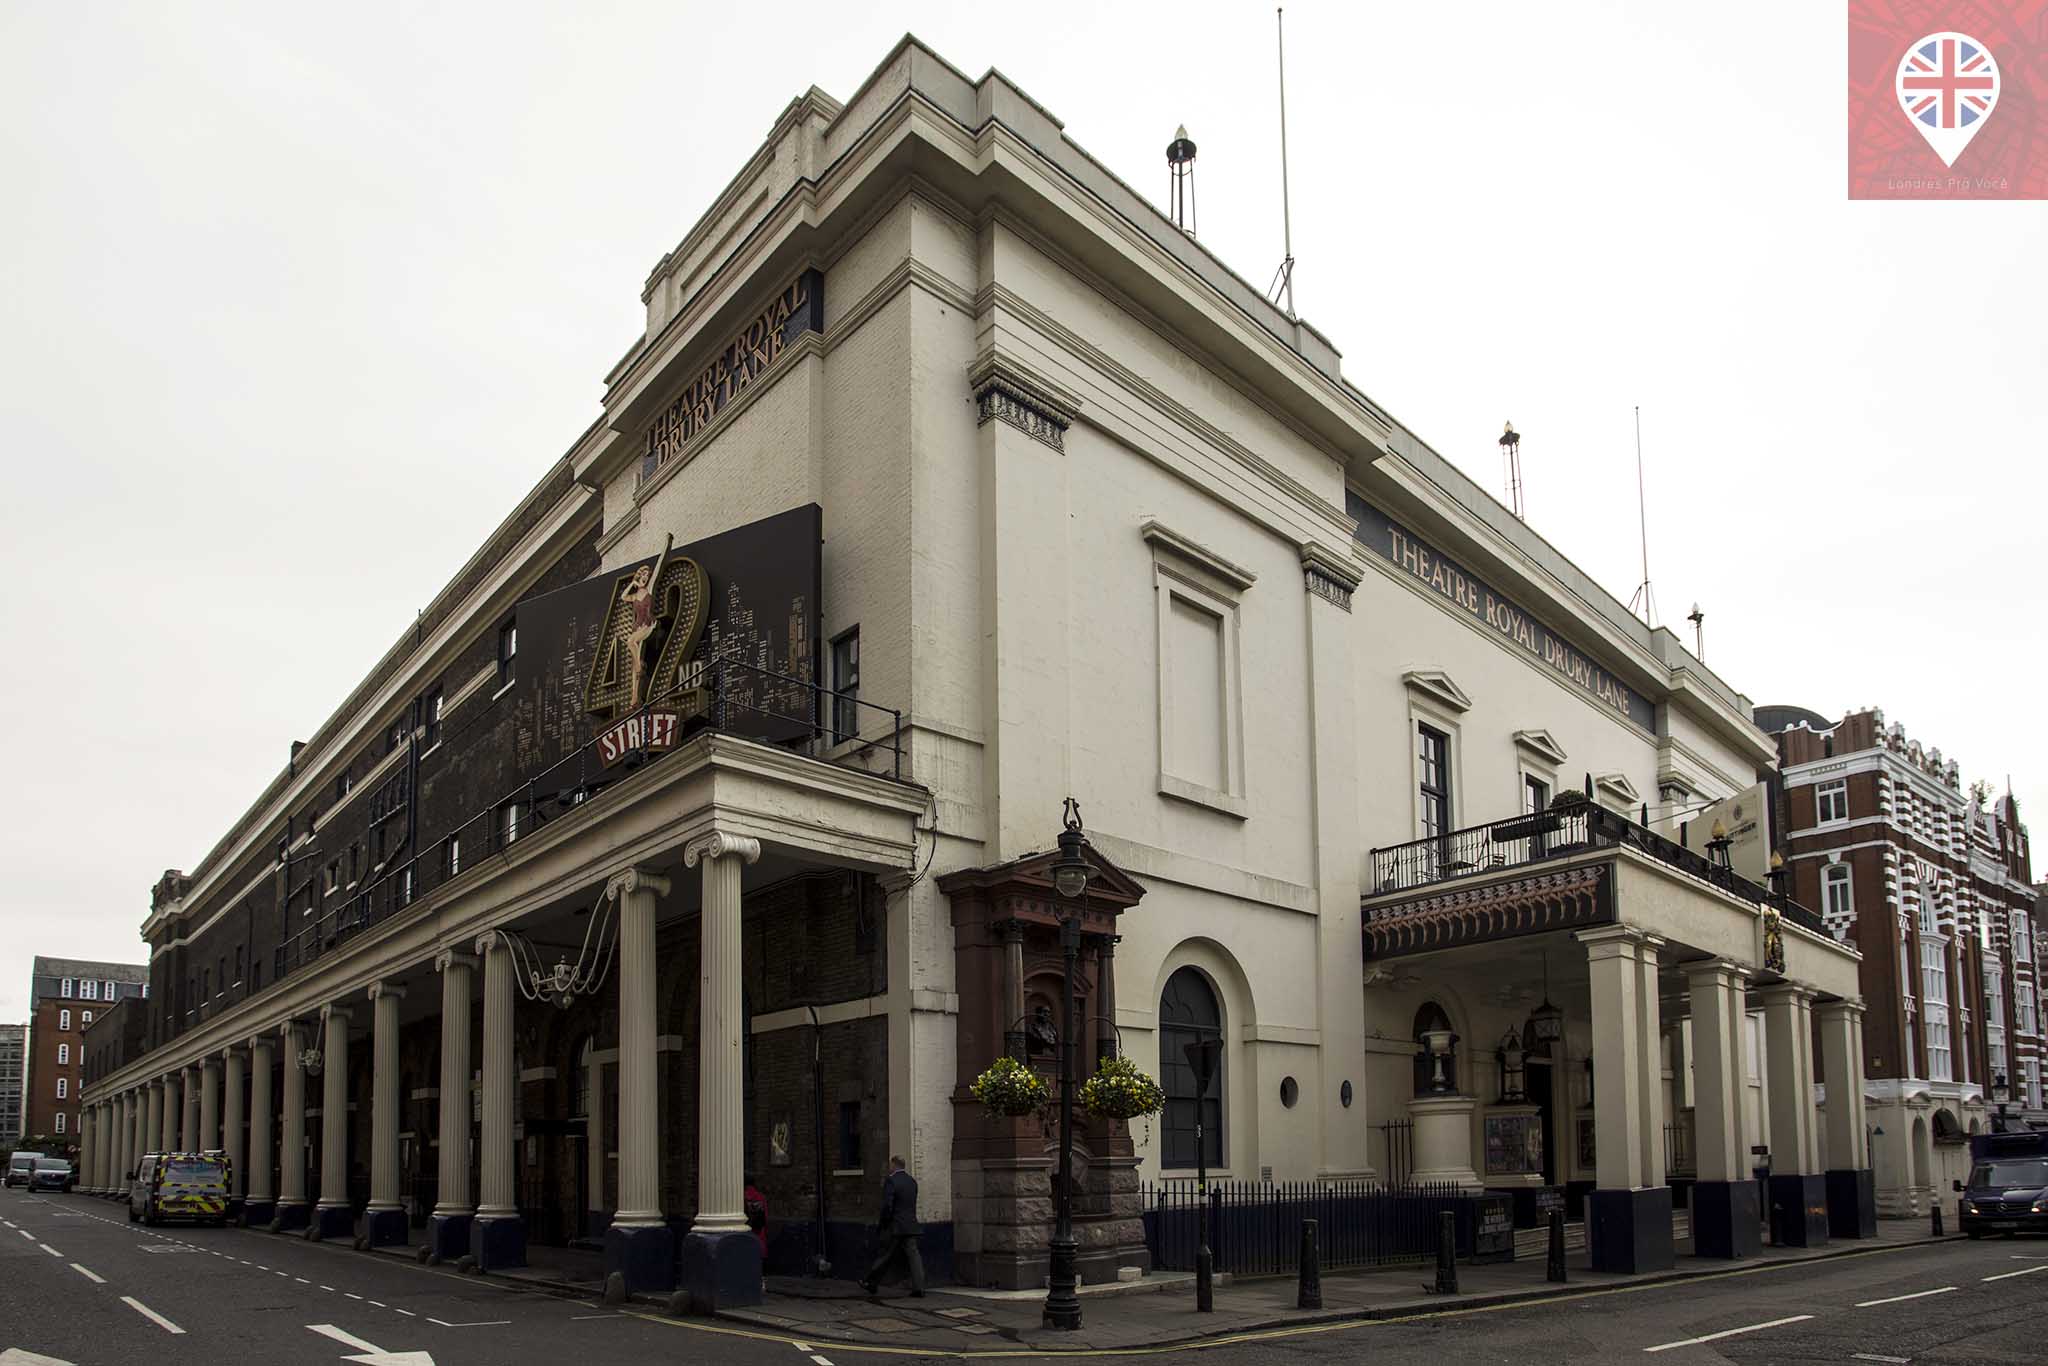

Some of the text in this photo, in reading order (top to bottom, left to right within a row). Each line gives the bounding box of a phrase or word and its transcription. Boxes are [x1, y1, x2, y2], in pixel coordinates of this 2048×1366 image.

[644, 280, 808, 456] THEATRE ROYAL
[657, 324, 785, 468] DRURY LANE
[1388, 526, 1630, 716] THEATRE ROYAL DRURY LANE
[602, 714, 677, 761] STREET
